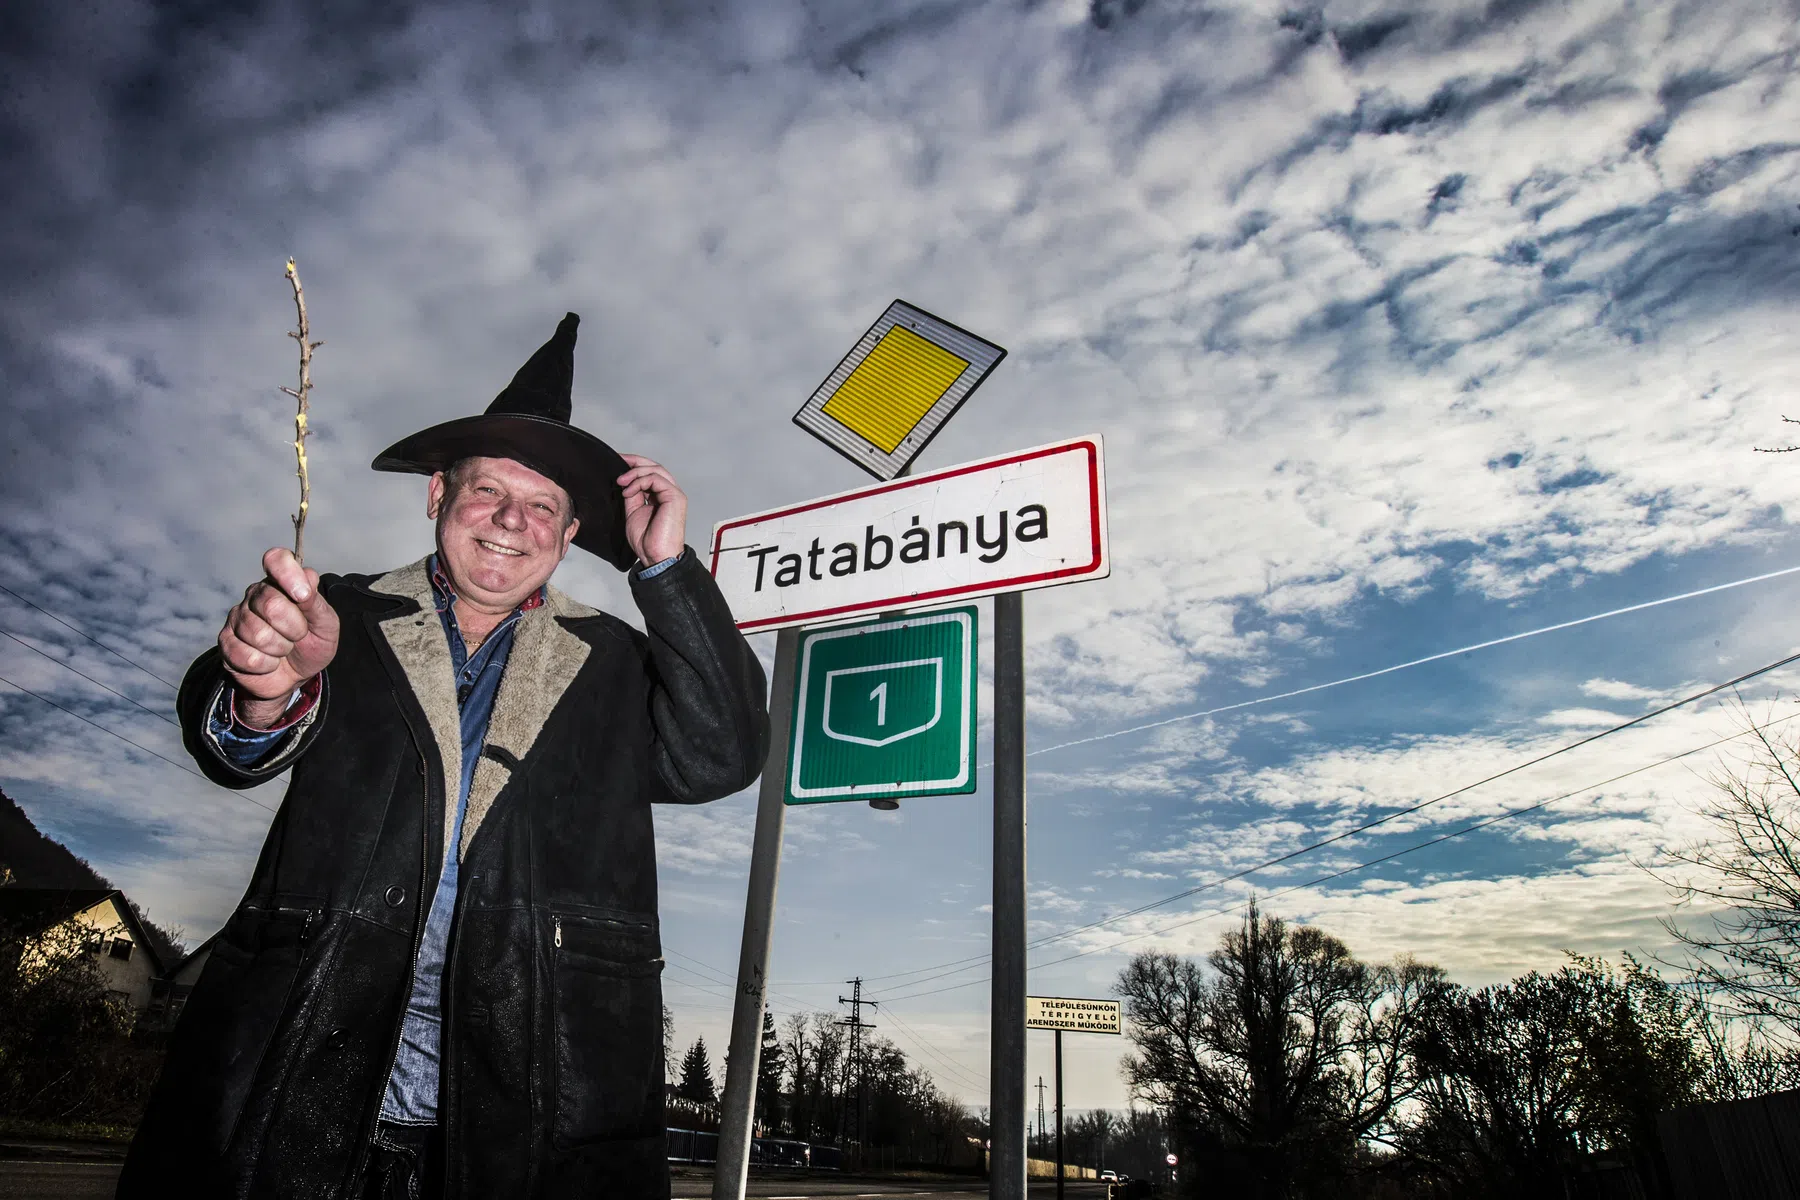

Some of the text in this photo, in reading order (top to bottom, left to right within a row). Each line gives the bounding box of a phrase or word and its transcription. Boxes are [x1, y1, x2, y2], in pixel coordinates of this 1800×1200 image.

[747, 503, 1048, 592] Tatabánya
[869, 682, 887, 726] 1
[1041, 1001, 1116, 1011] TELEPÜLÉSÜNKÖN
[1041, 1010, 1116, 1021] TÉRFIGYELŐ
[1027, 1018, 1117, 1030] ARENDSZER MŰKÖDIK
